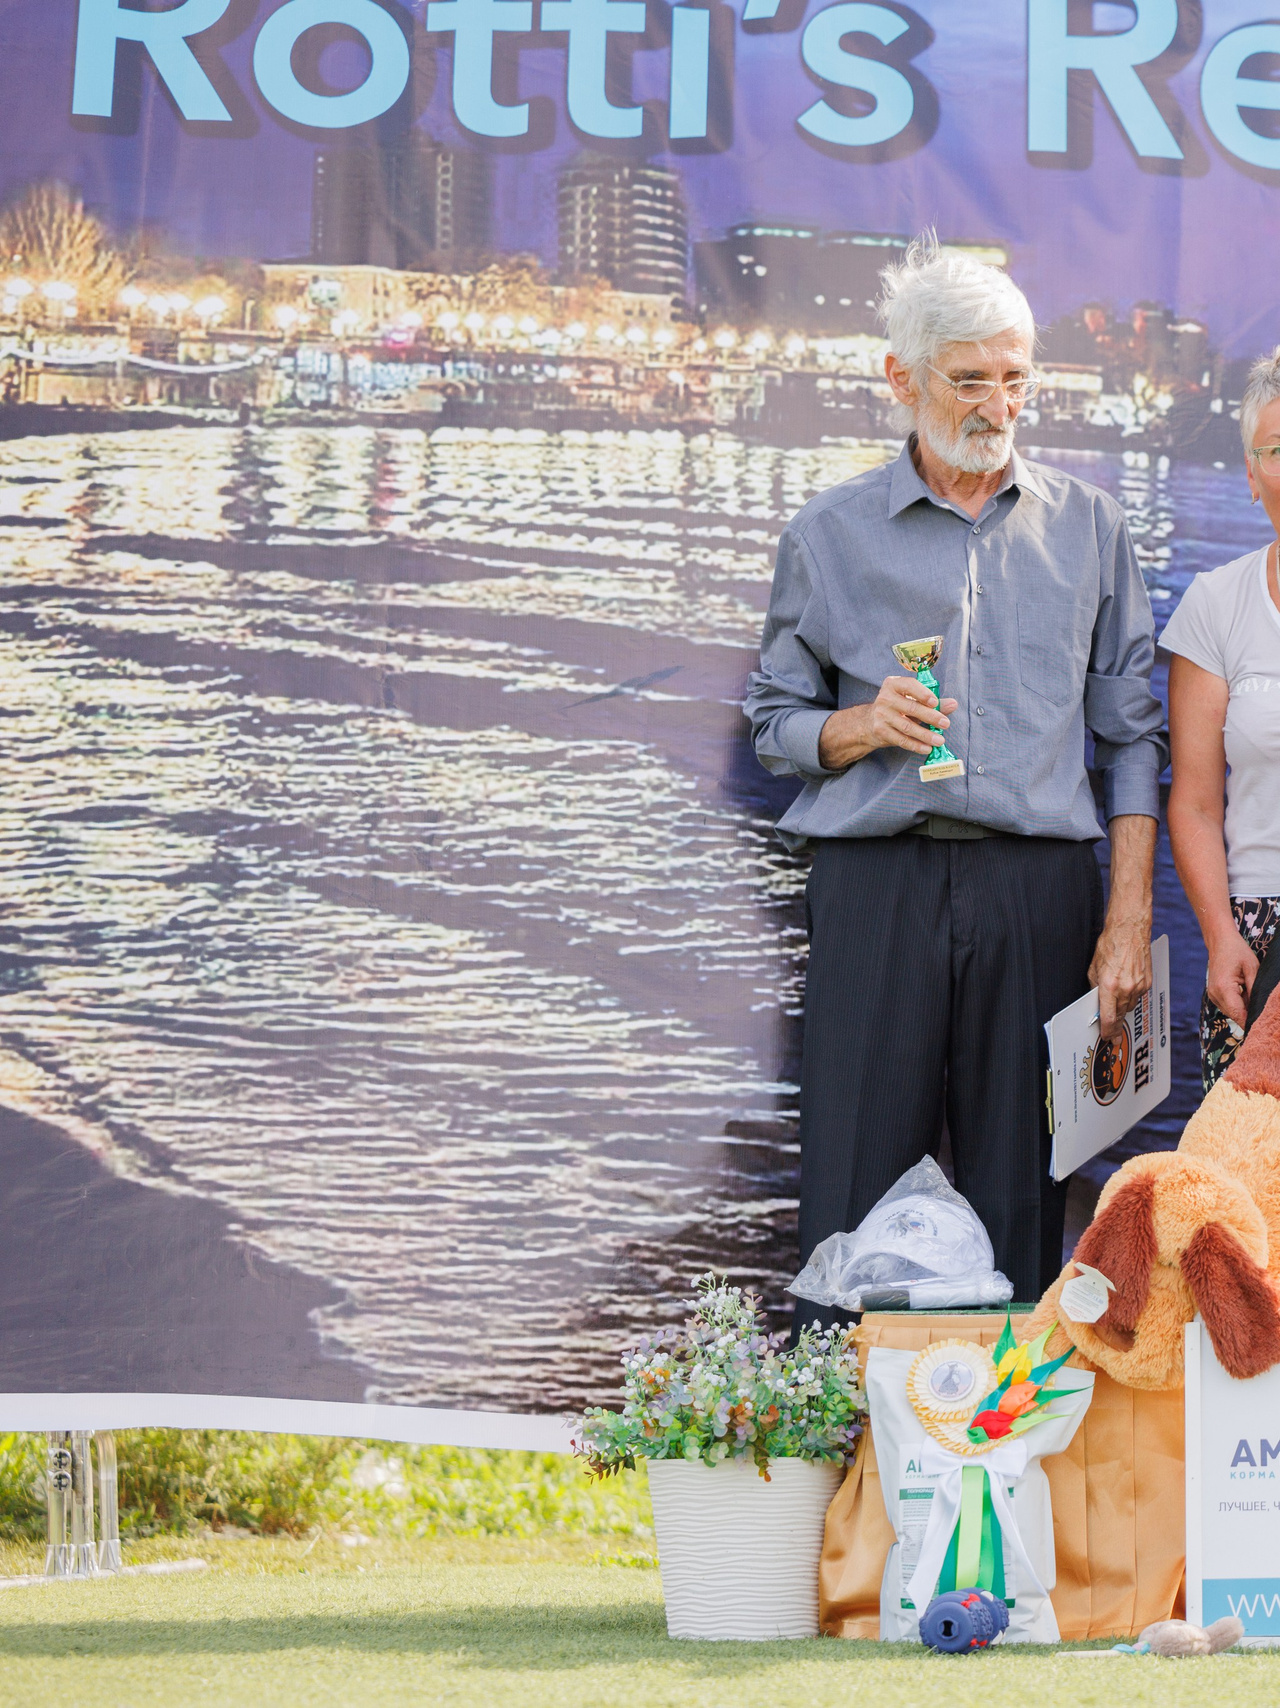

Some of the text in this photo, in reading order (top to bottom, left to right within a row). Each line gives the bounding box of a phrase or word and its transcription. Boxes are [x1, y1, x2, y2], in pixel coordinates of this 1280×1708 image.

[1134, 1040, 1149, 1094] IFR
[1230, 1470, 1276, 1480] КОРМА
[1218, 1500, 1270, 1513] ЛУЧШЕЕ,
